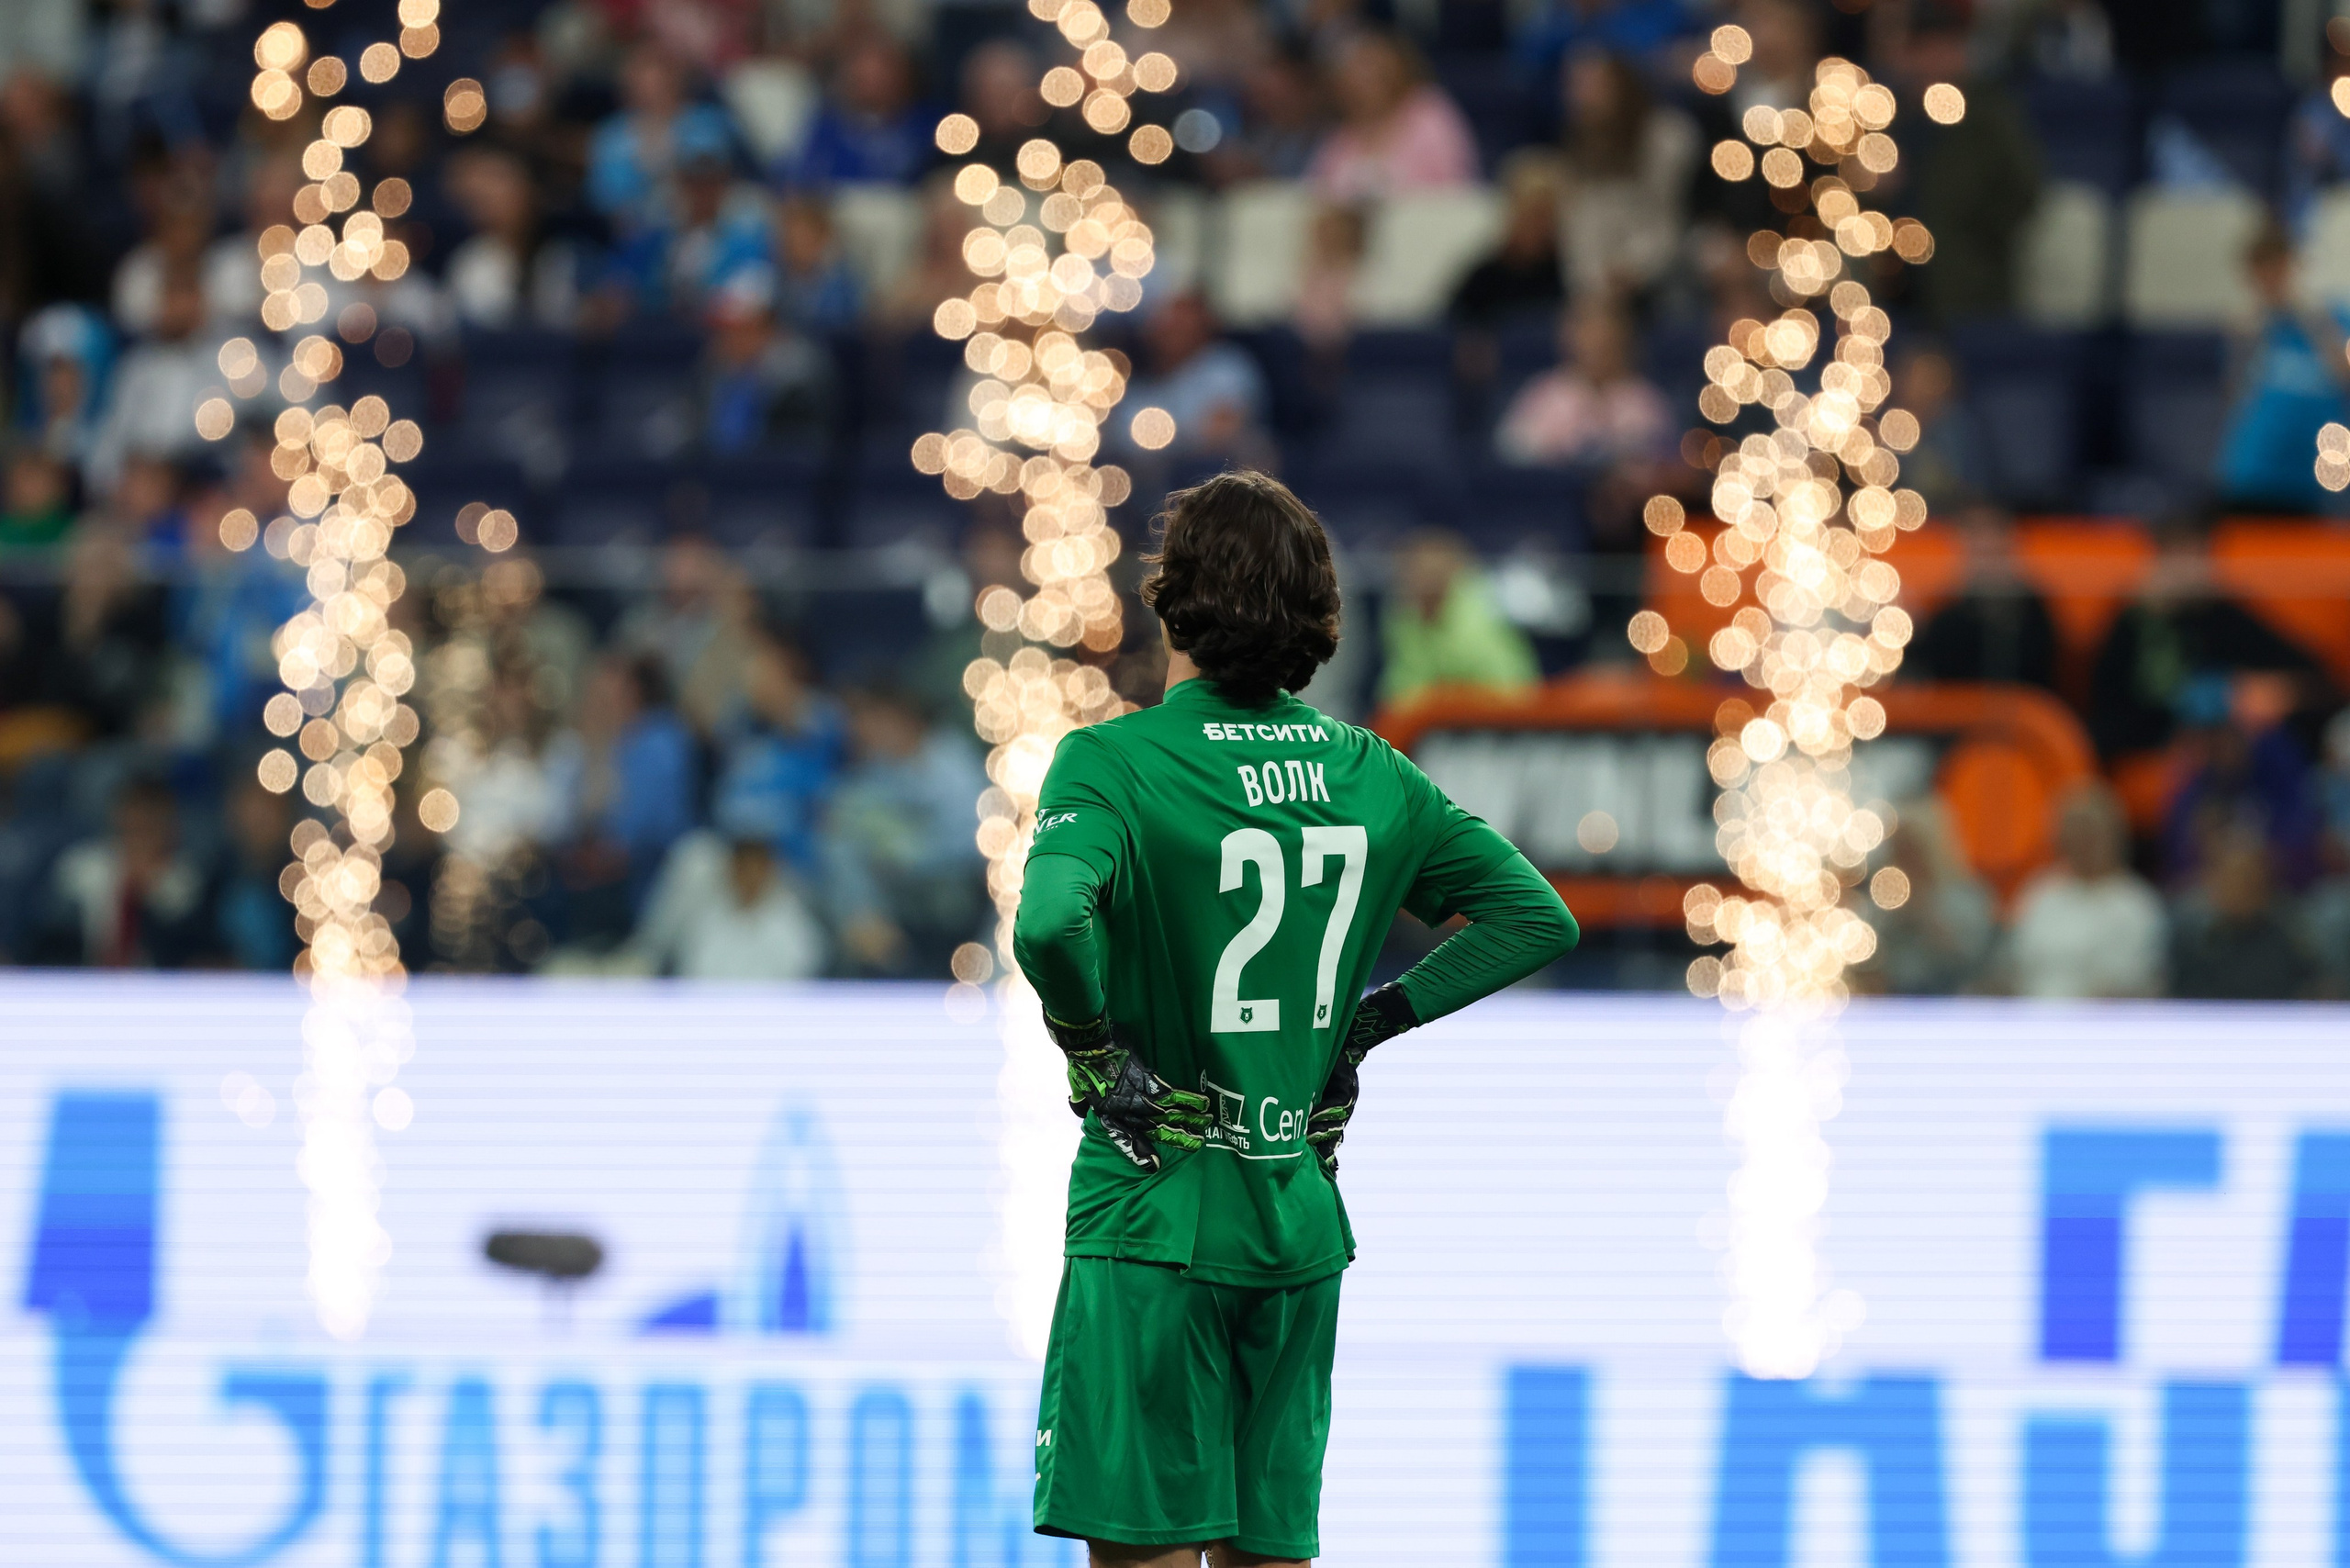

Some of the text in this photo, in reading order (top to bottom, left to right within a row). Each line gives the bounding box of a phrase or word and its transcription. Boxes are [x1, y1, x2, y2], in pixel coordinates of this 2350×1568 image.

[1203, 722, 1330, 742] БЕТСИТИ
[1237, 760, 1331, 808] ВОЛК
[1211, 826, 1369, 1033] 27
